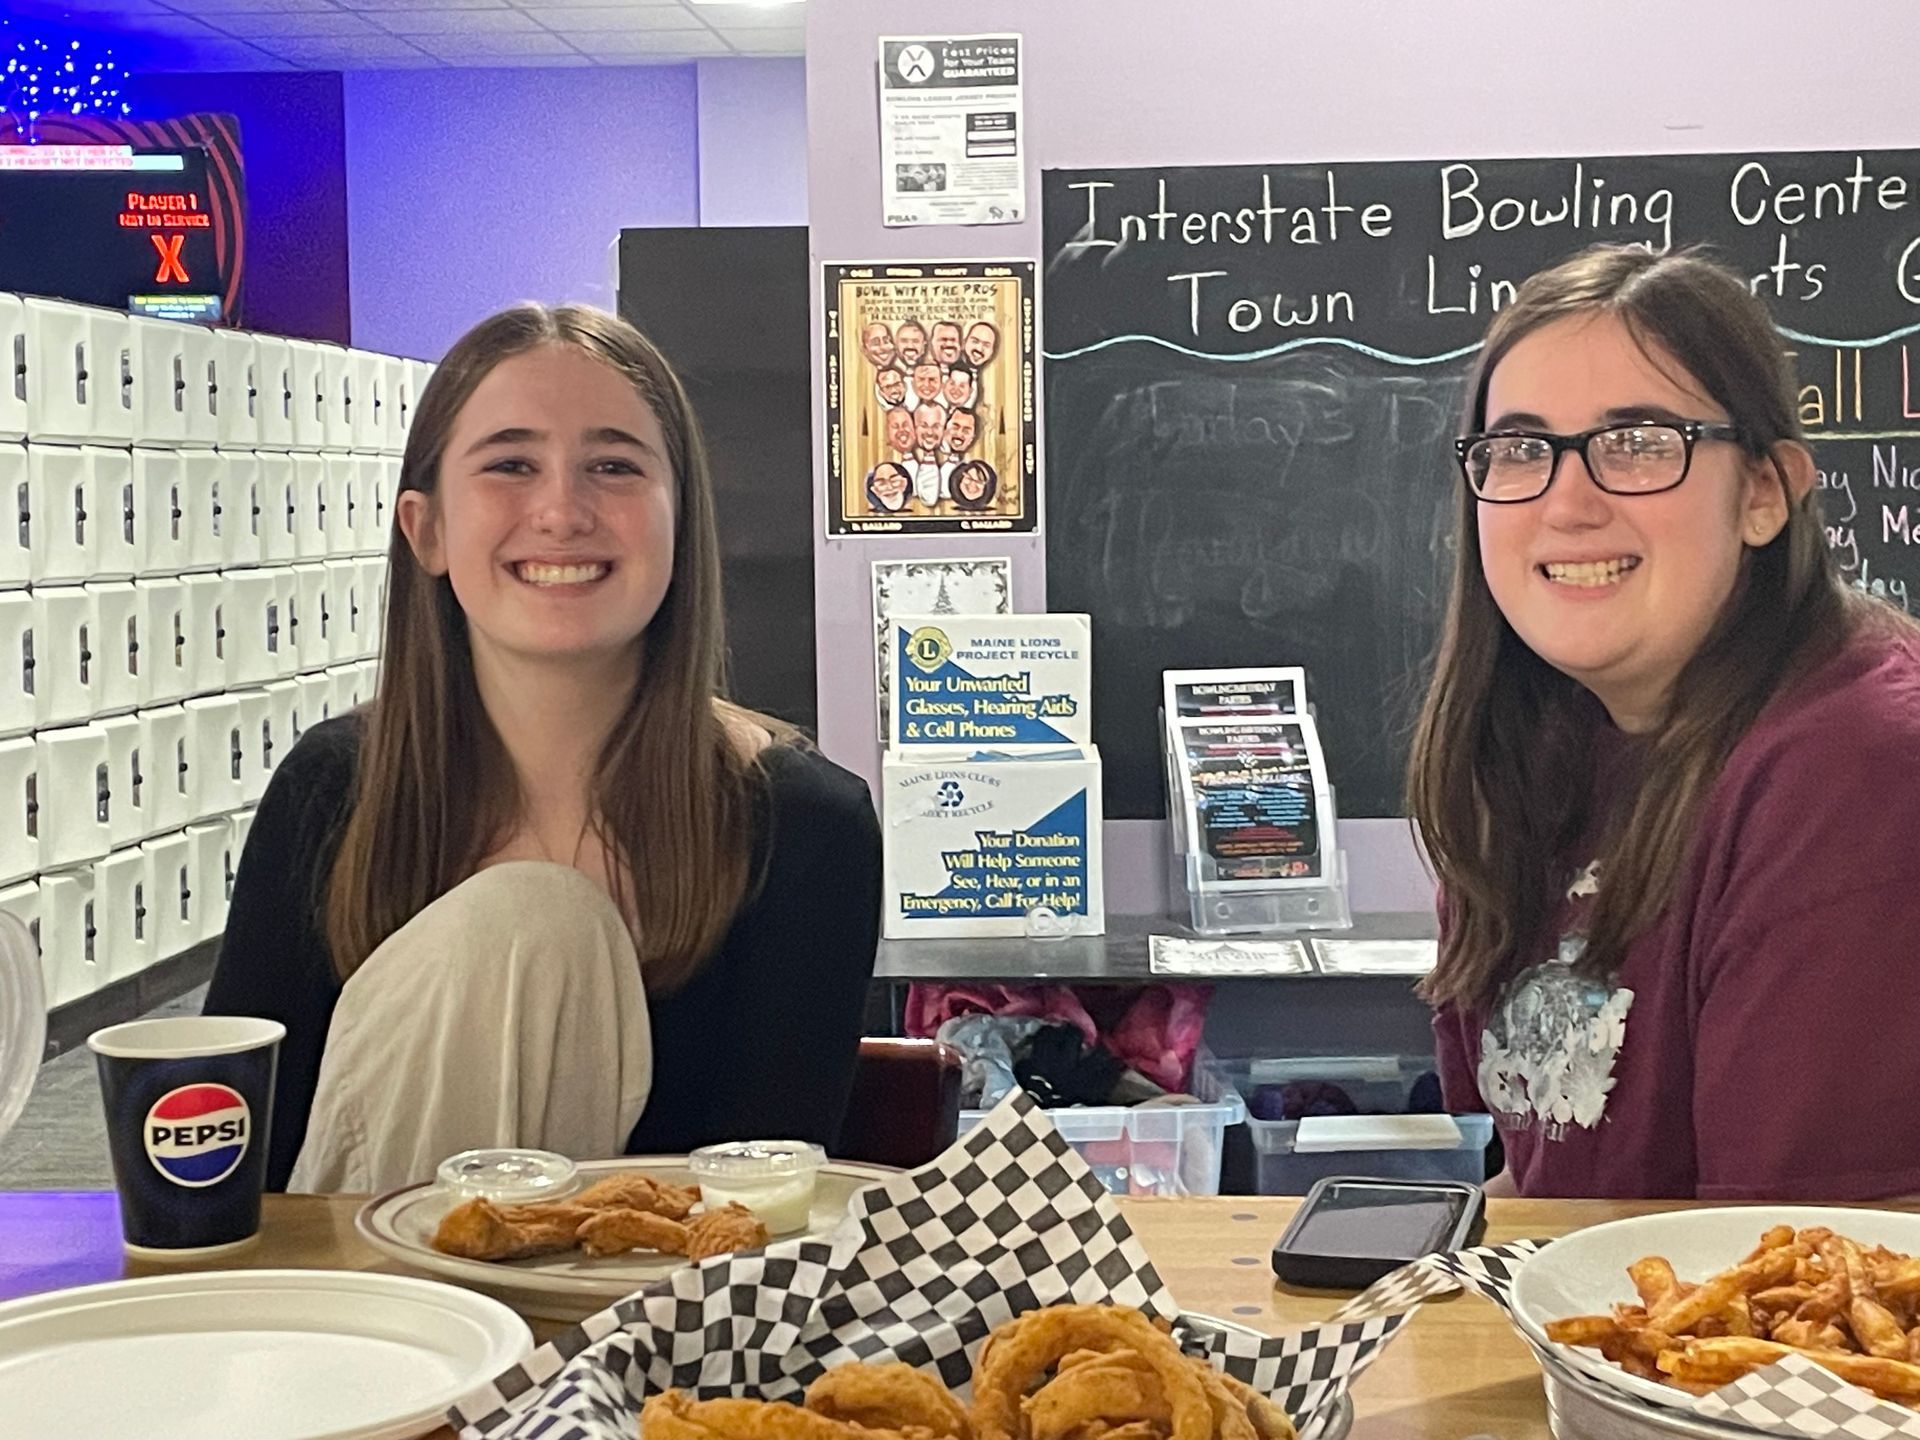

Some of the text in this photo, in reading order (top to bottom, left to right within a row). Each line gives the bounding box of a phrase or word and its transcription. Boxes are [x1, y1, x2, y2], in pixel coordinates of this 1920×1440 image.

[942, 66, 1016, 78] GUARANTEED
[189, 193, 198, 210] 1
[1066, 169, 1393, 248] Interstate
[1441, 162, 1673, 257] Bowling
[856, 283, 998, 298] BOWL WITH THE PROS
[1168, 270, 1354, 336] Town
[1428, 254, 1517, 314] Lin
[1750, 233, 1826, 302] rts
[1799, 349, 1862, 425] all
[971, 638, 1062, 647] MAINE LIONS
[956, 650, 1079, 660] PROJECT RECYCLE
[905, 673, 1028, 692] Your Unwanted
[905, 696, 1074, 719] Glasses, Hearing Aids
[905, 720, 1017, 738] & Cell Phones
[899, 770, 1001, 788] MAINE LIONS CLUBS
[979, 832, 1080, 848] Your Donation
[945, 853, 1081, 872] Will Help Someone
[952, 874, 1081, 890] See, Hear, or in an
[902, 894, 983, 914] Emergency,
[984, 892, 1012, 909] Call
[1042, 891, 1081, 912] Help!
[151, 1116, 246, 1147] PEPSI
